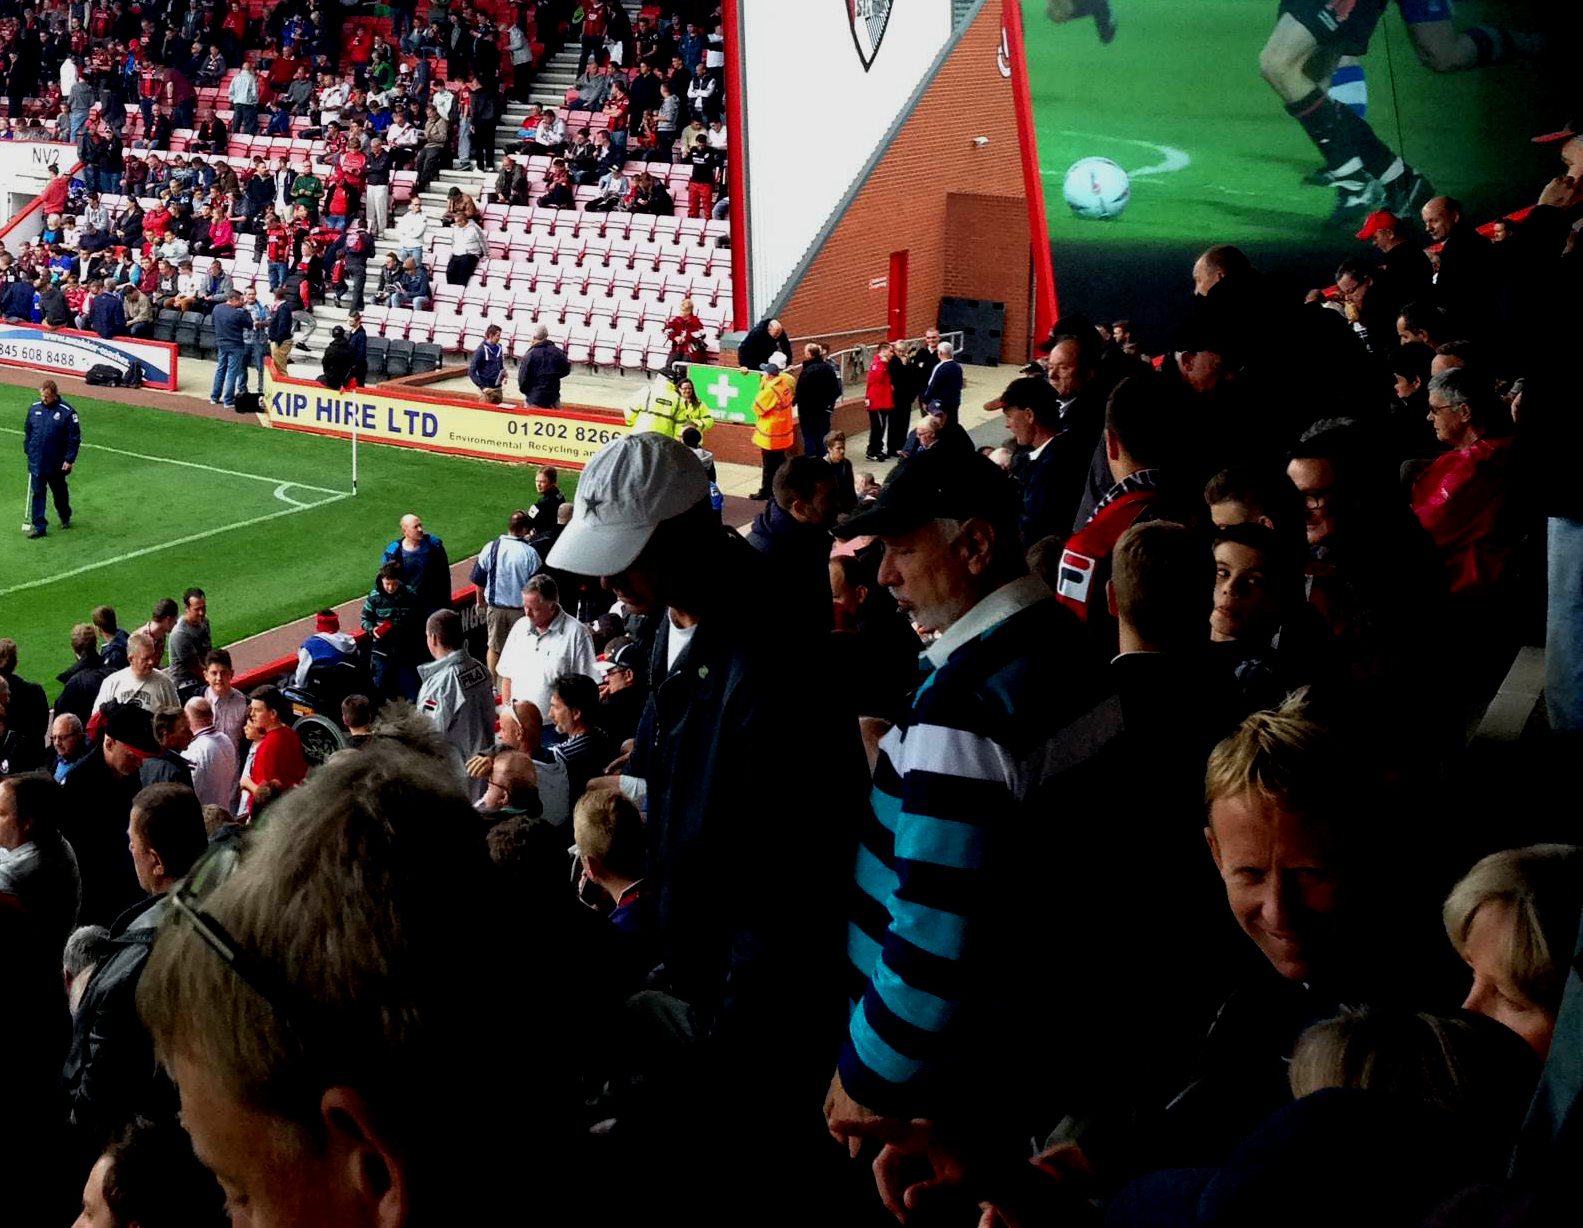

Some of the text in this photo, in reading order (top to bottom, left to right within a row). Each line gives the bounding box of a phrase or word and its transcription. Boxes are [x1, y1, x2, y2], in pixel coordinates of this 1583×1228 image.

[33, 147, 60, 166] NV2
[21, 346, 43, 363] 608
[46, 349, 75, 367] 8488
[316, 396, 377, 430] HIRE
[388, 408, 439, 439] LTD
[507, 419, 568, 439] 01202
[449, 431, 580, 459] Environmental Recycling
